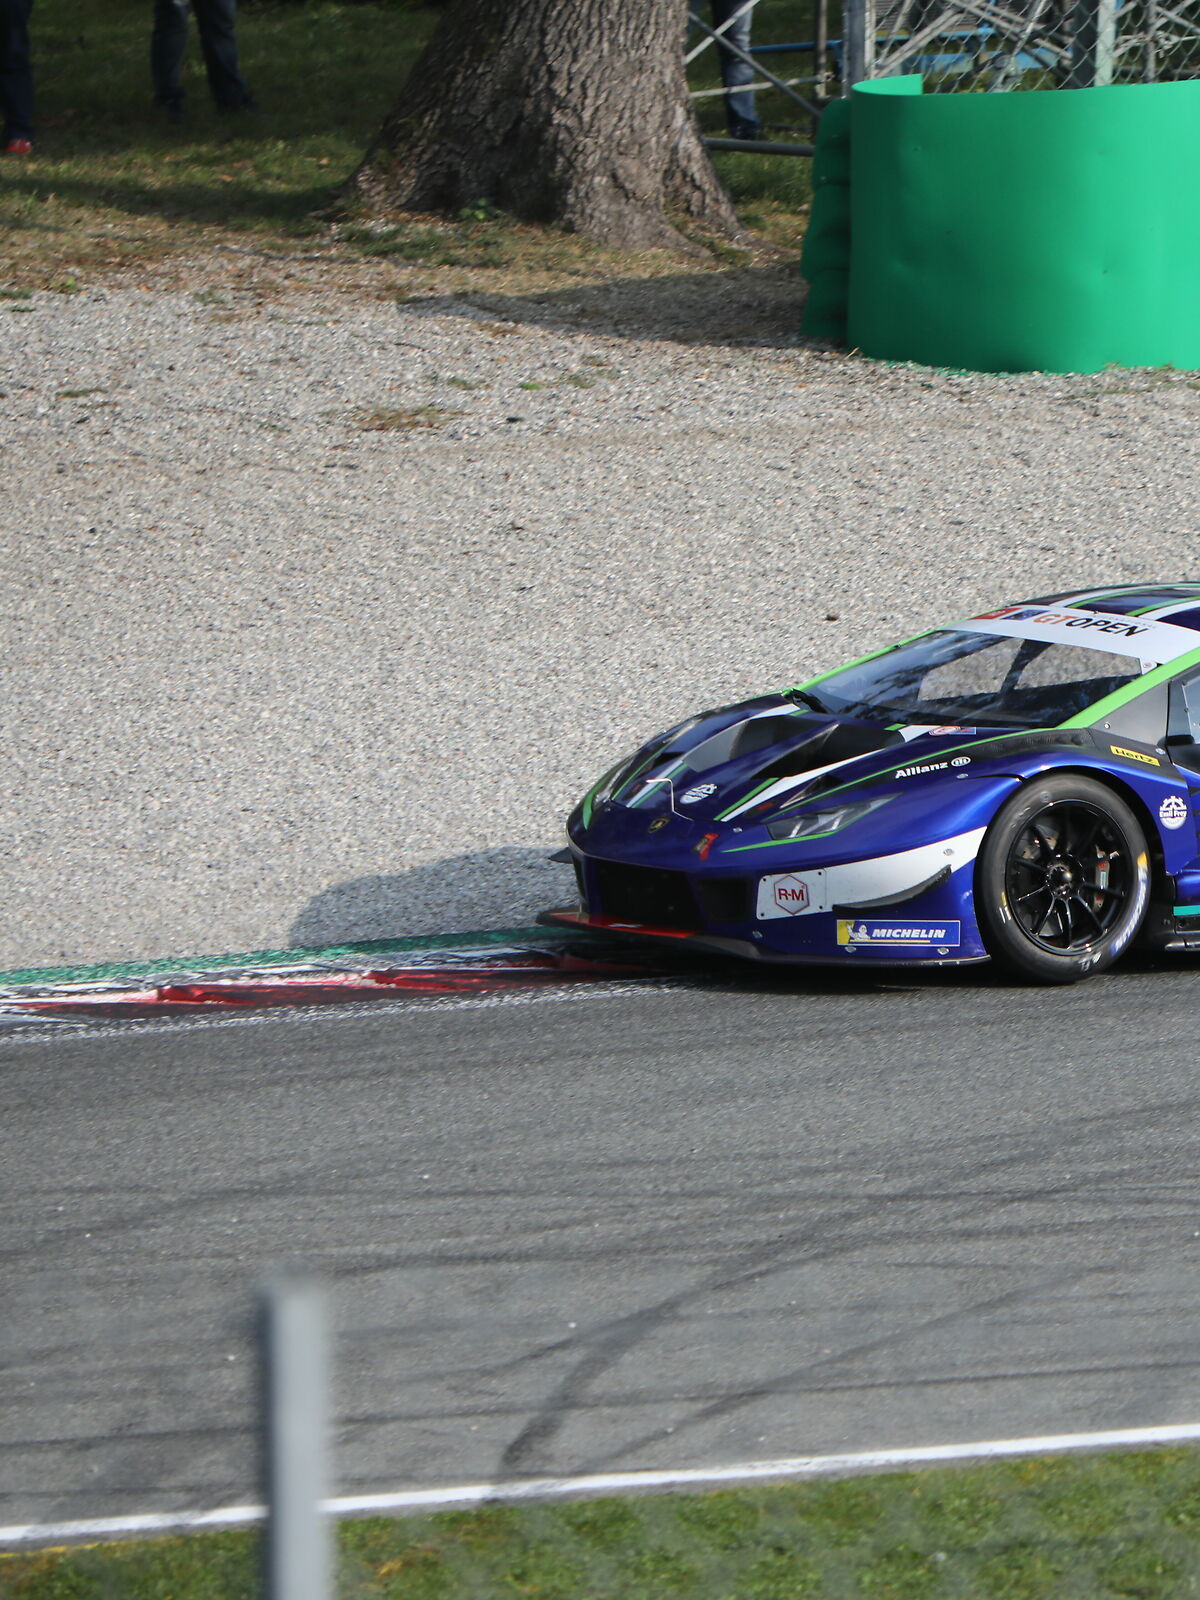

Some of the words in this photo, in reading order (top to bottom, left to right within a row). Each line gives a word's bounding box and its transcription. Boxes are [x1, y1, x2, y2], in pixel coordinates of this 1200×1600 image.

[1115, 748, 1154, 763] Hertz
[895, 761, 948, 779] Allianz
[778, 888, 804, 901] R-M
[872, 928, 946, 938] MICHELIN
